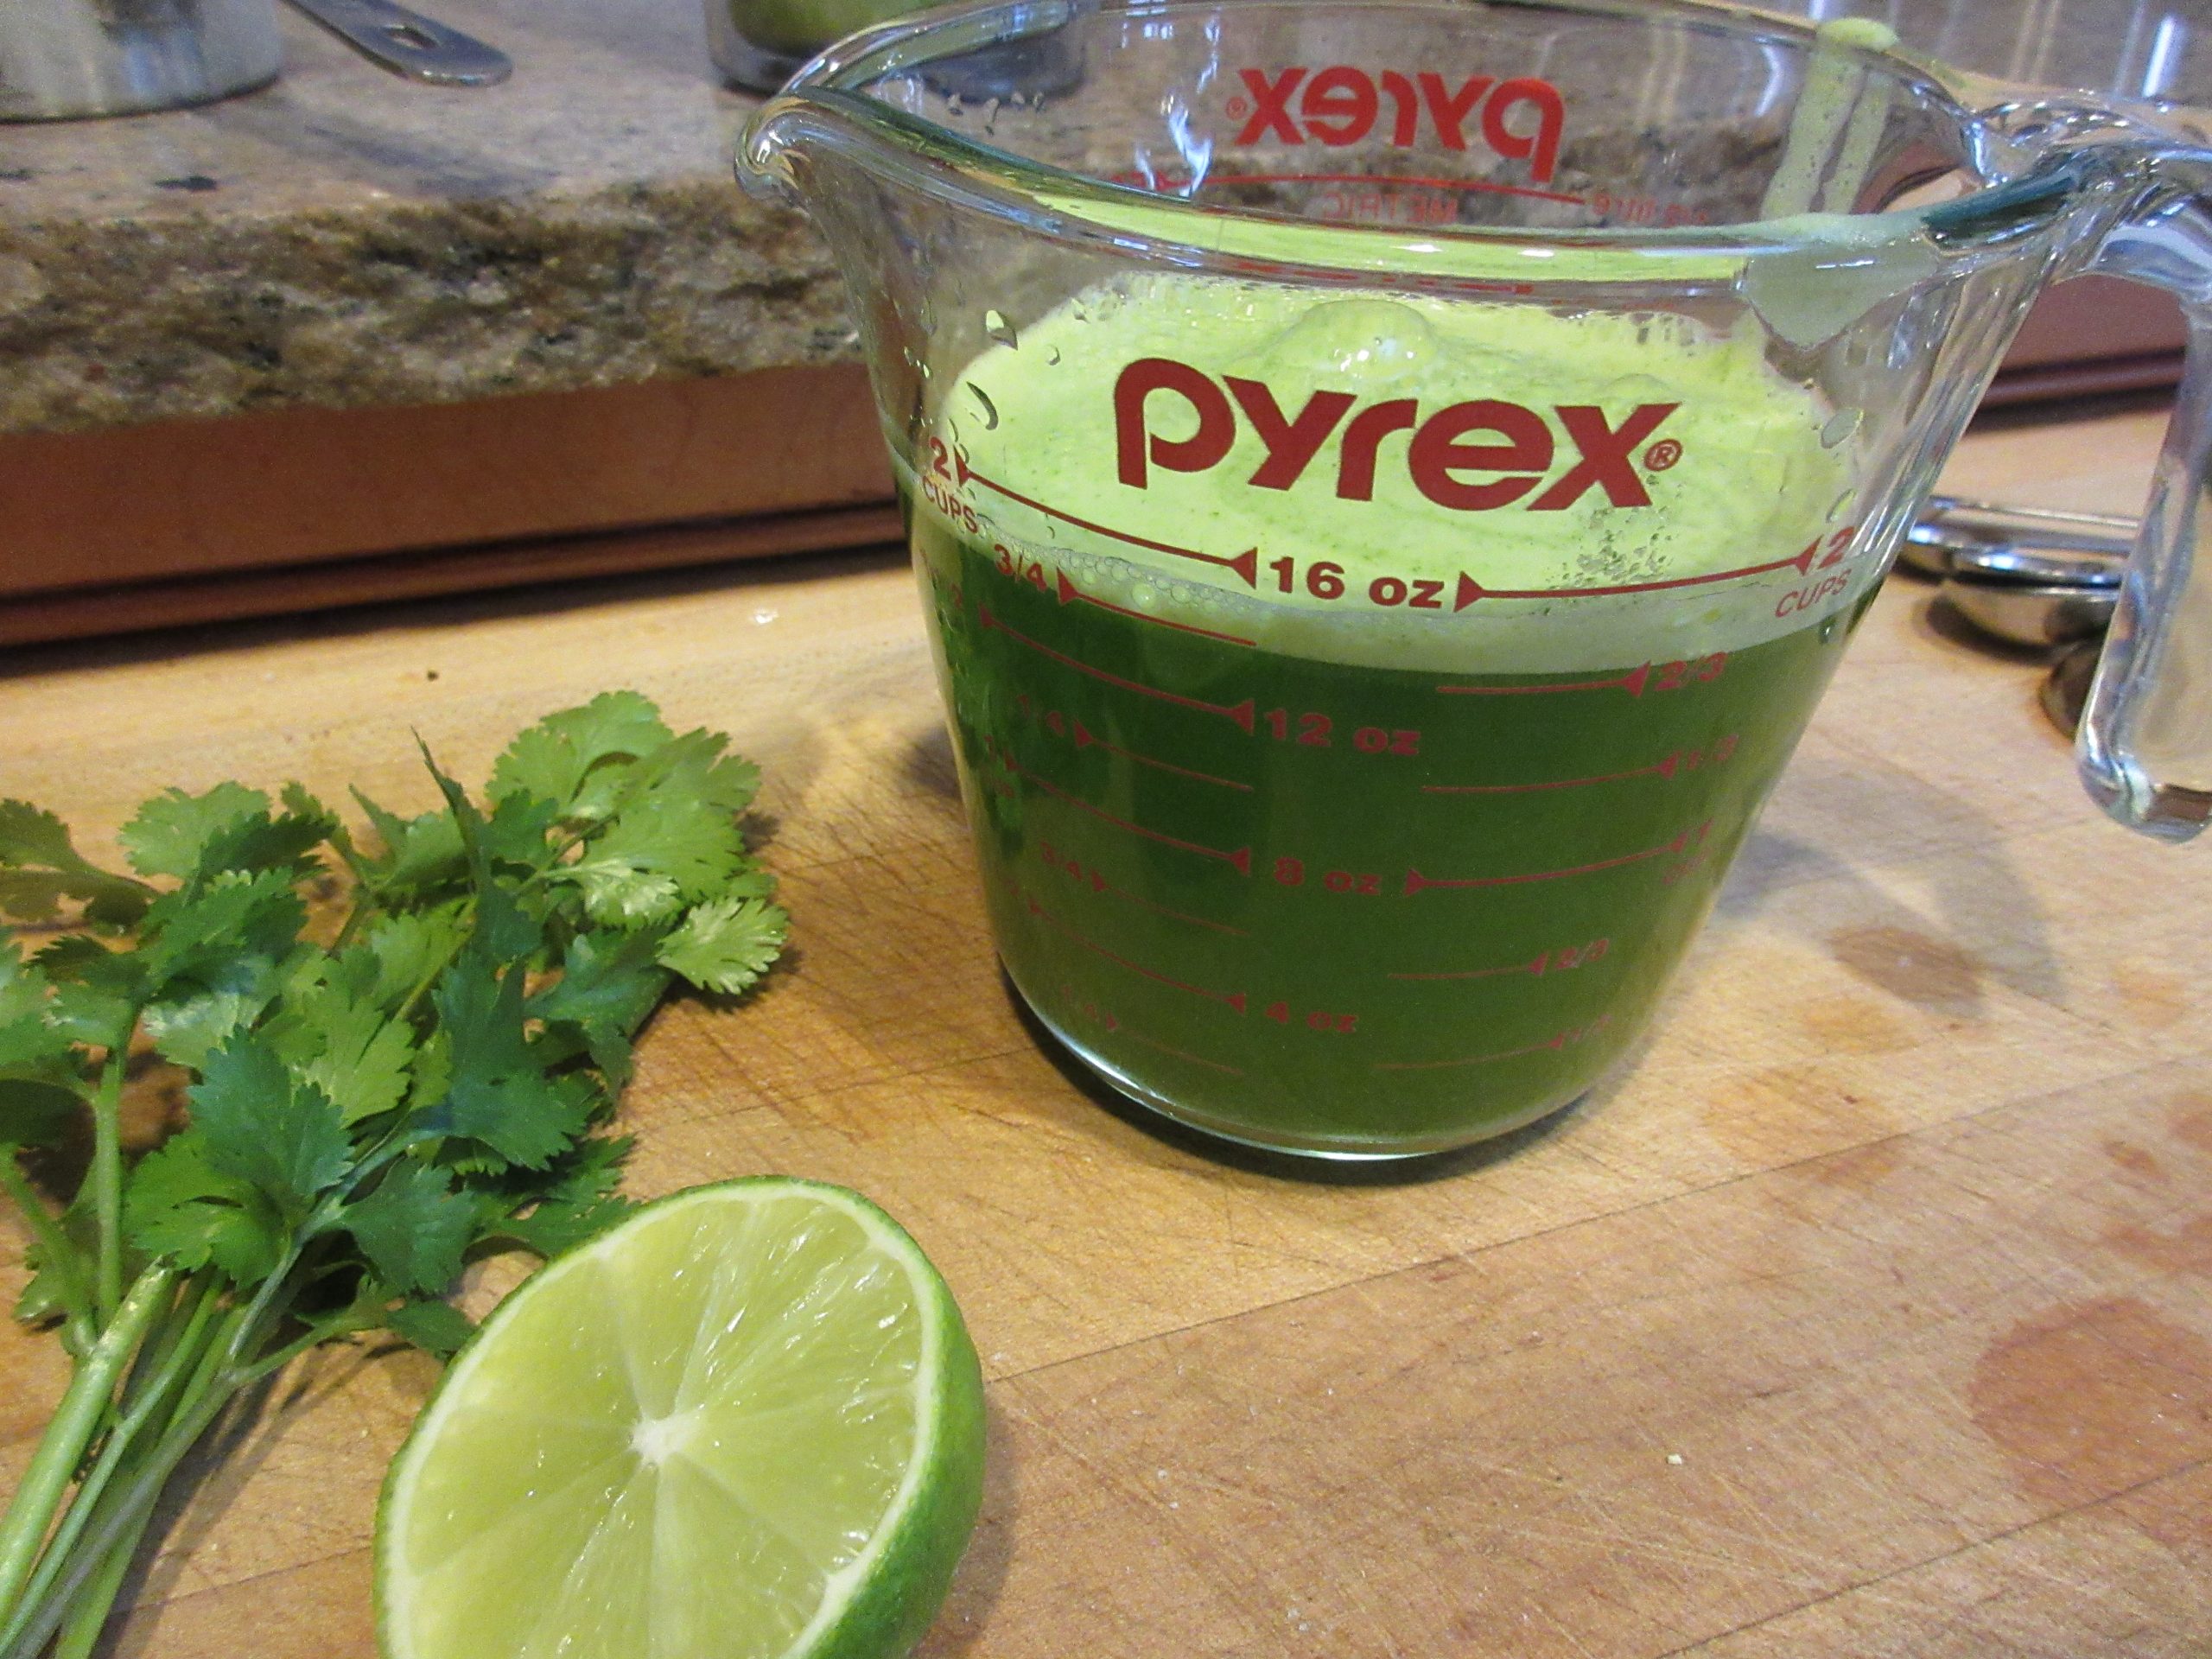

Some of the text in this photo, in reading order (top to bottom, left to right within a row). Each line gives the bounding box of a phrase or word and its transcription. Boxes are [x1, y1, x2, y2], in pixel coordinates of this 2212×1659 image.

[929, 436, 952, 481] 2
[921, 474, 979, 534] CUPS
[994, 543, 1048, 592] 3/4
[1817, 525, 1855, 570] 2
[1268, 555, 1445, 610] 16 oz
[1774, 568, 1853, 618] CUPS
[1264, 707, 1421, 757] 12 oz
[1274, 855, 1382, 896] 8 oz
[1265, 1001, 1359, 1033] 4 oz
